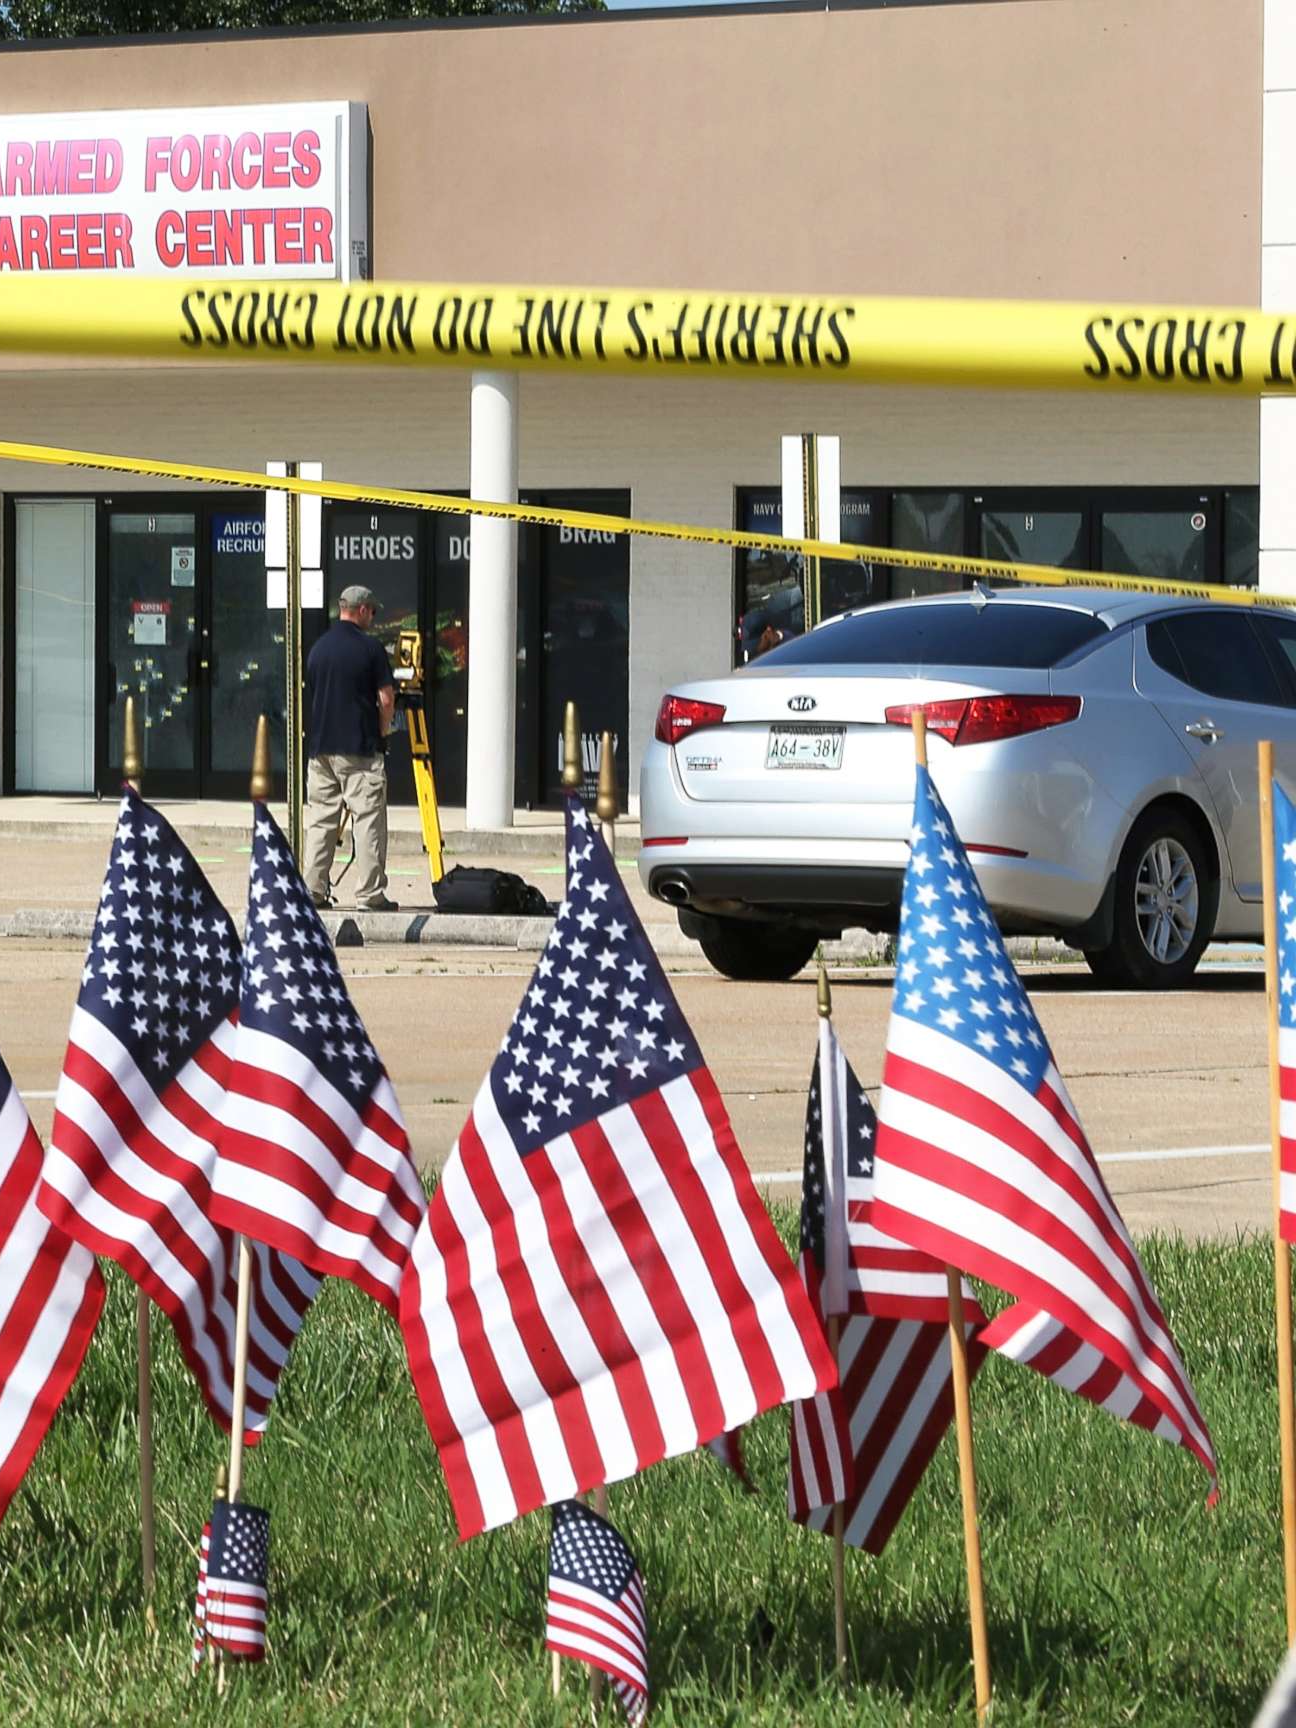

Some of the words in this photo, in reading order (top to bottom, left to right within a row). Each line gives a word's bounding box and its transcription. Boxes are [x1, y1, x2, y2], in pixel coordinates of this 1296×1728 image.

[145, 129, 323, 193] FORCES
[154, 207, 335, 267] CENTER
[179, 290, 319, 353] CROSS
[332, 294, 417, 354] NOT
[432, 295, 494, 357] DO
[511, 297, 610, 361] LINE
[624, 301, 856, 368] SHERIFF'S
[1083, 317, 1247, 386] CROSS
[753, 503, 774, 516] NAVY
[334, 535, 415, 561] HEROES
[140, 602, 163, 612] OPEN
[790, 697, 813, 711] KIA
